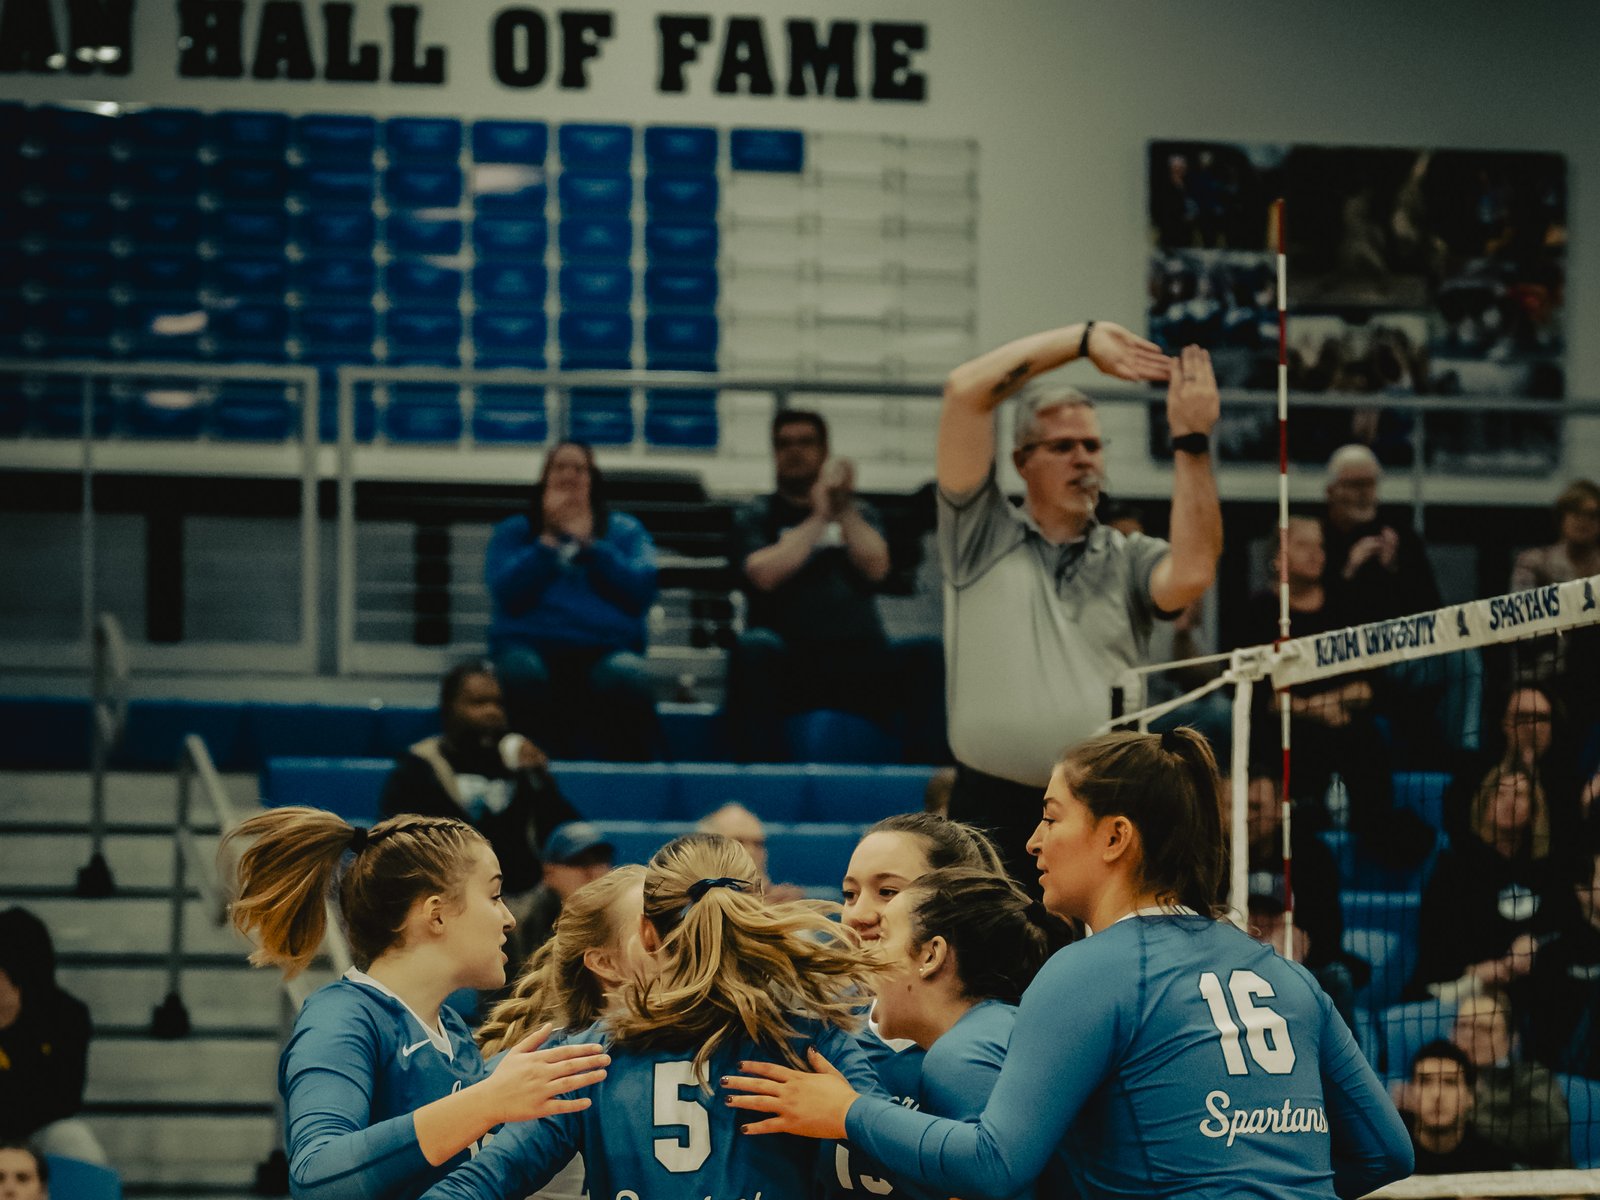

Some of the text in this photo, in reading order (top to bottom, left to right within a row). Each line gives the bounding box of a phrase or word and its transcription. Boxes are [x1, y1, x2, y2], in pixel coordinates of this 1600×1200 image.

[178, 1, 446, 86] HALL
[492, 7, 615, 89] OF
[655, 15, 930, 103] FAME
[1489, 586, 1560, 630] SPARTANS
[1199, 970, 1296, 1076] 16
[654, 1061, 711, 1173] 5
